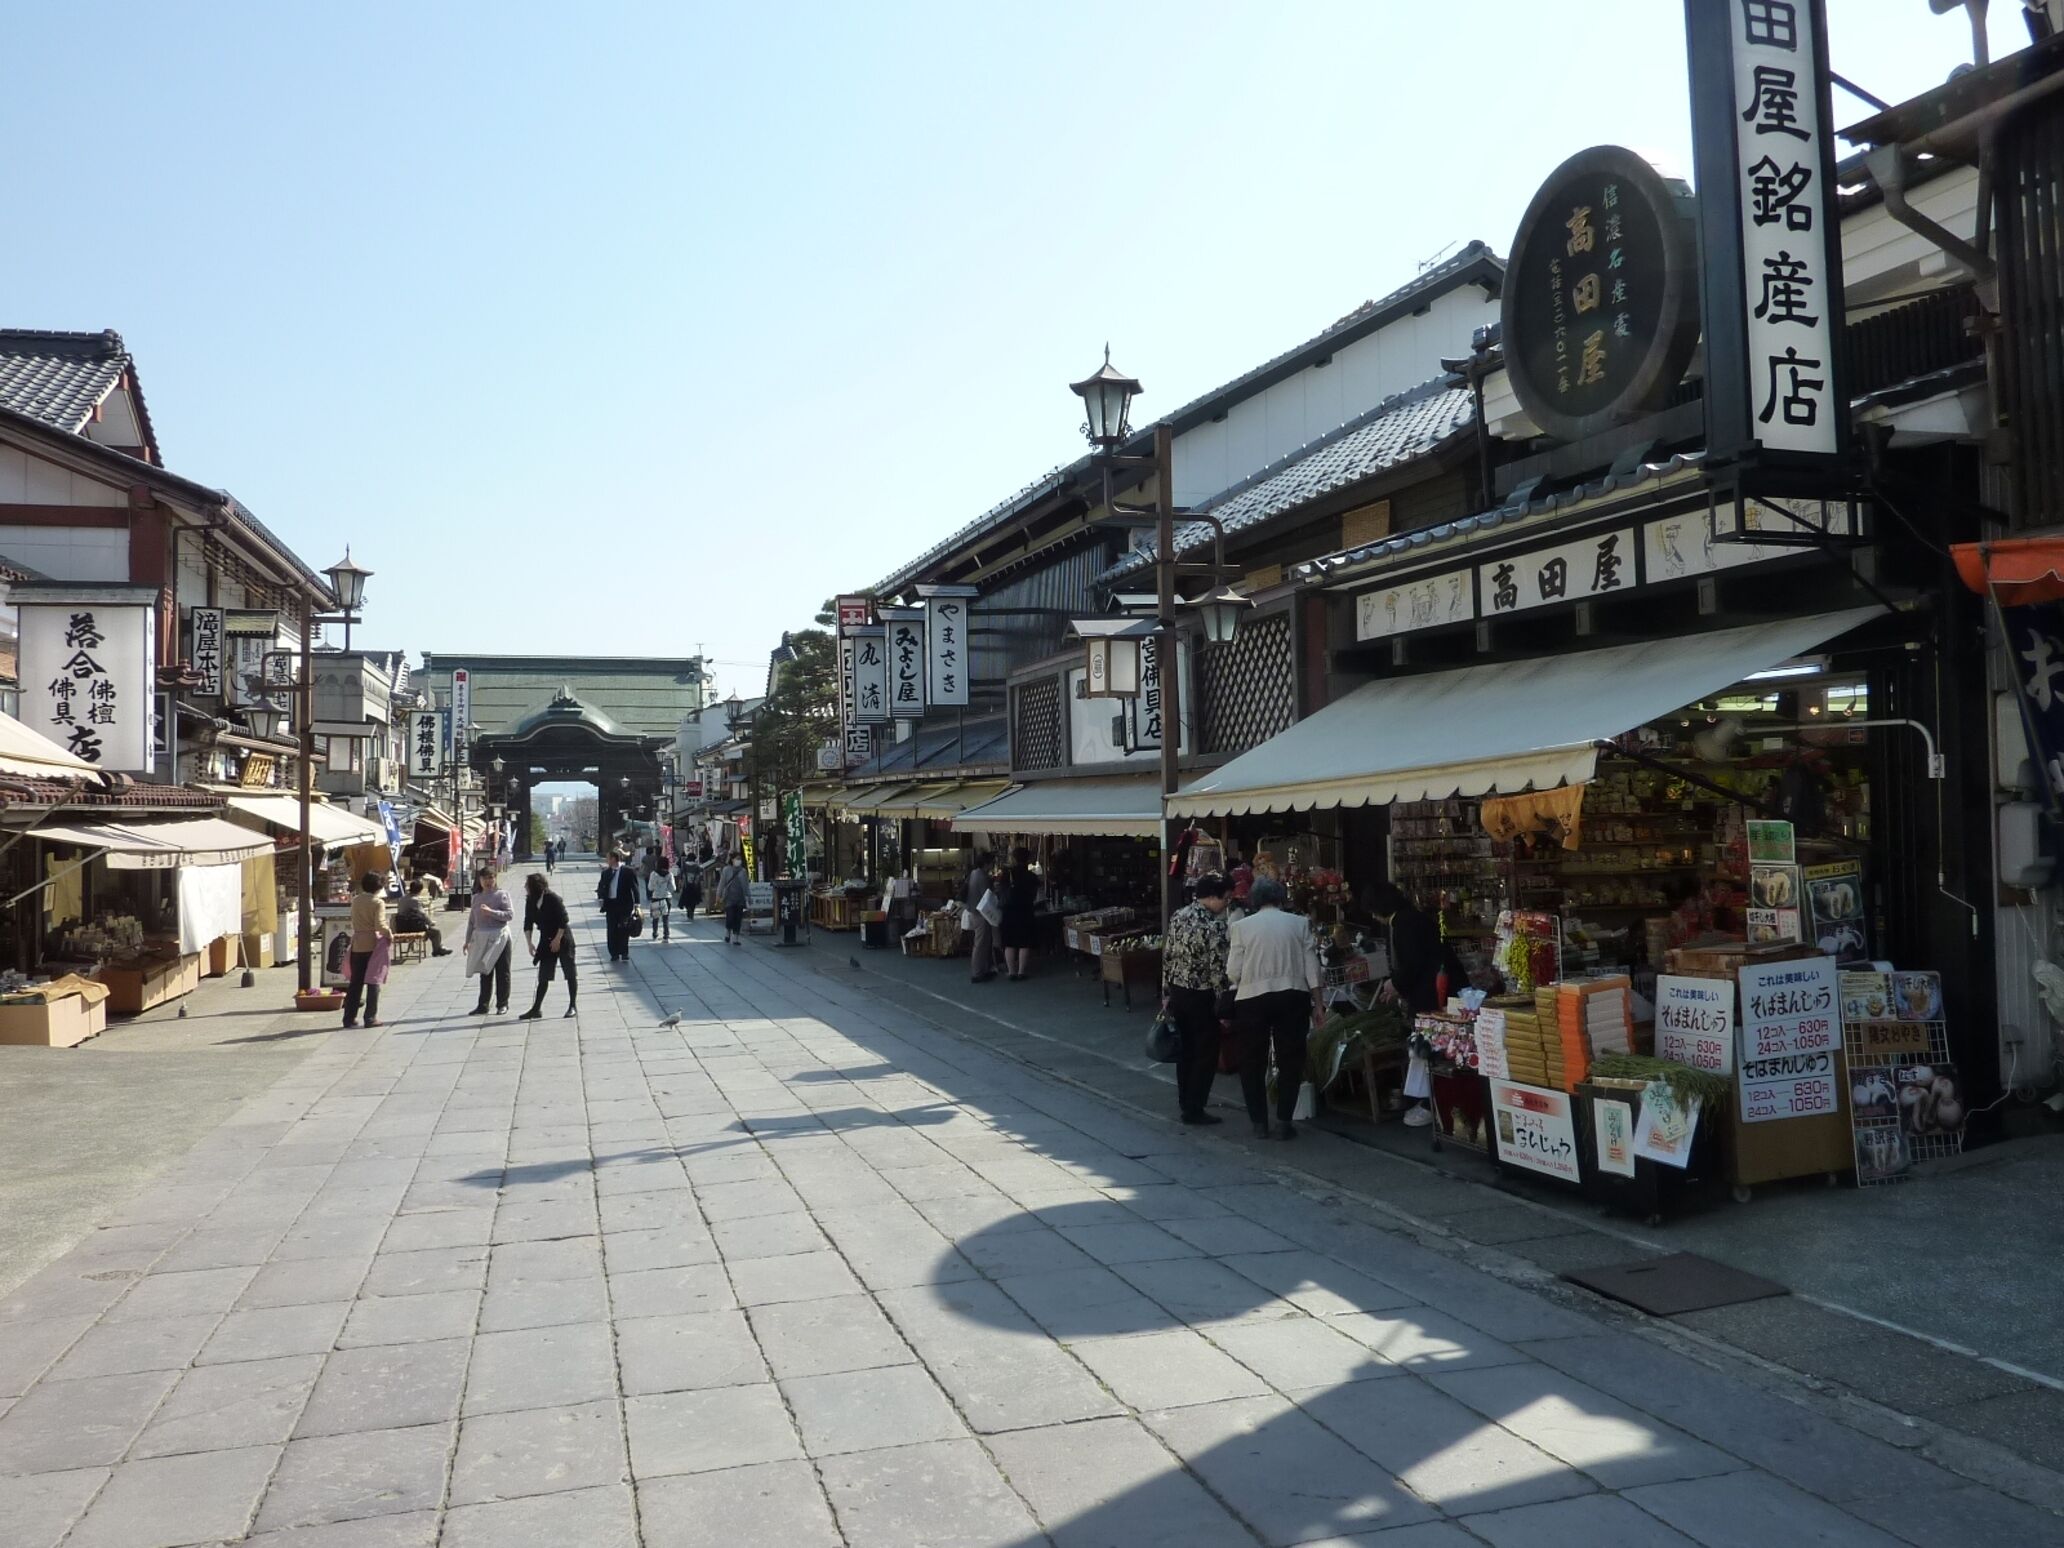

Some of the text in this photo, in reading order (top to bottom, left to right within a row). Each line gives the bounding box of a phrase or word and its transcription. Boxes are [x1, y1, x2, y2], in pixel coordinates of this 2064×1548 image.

[1565, 206, 1607, 385] 高田屋
[1491, 534, 1625, 611] 高田屋
[895, 626, 920, 703] みよし屋
[937, 603, 960, 694] やまさき
[858, 641, 881, 710] 丸清
[1669, 987, 1719, 1002] これは美味しい
[1750, 986, 1831, 1019] そばまんじゅう
[1758, 970, 1820, 987] これは美味しい
[1662, 1004, 1727, 1033] そばまんじゅう
[1742, 1051, 1829, 1080] そばまんじゅう
